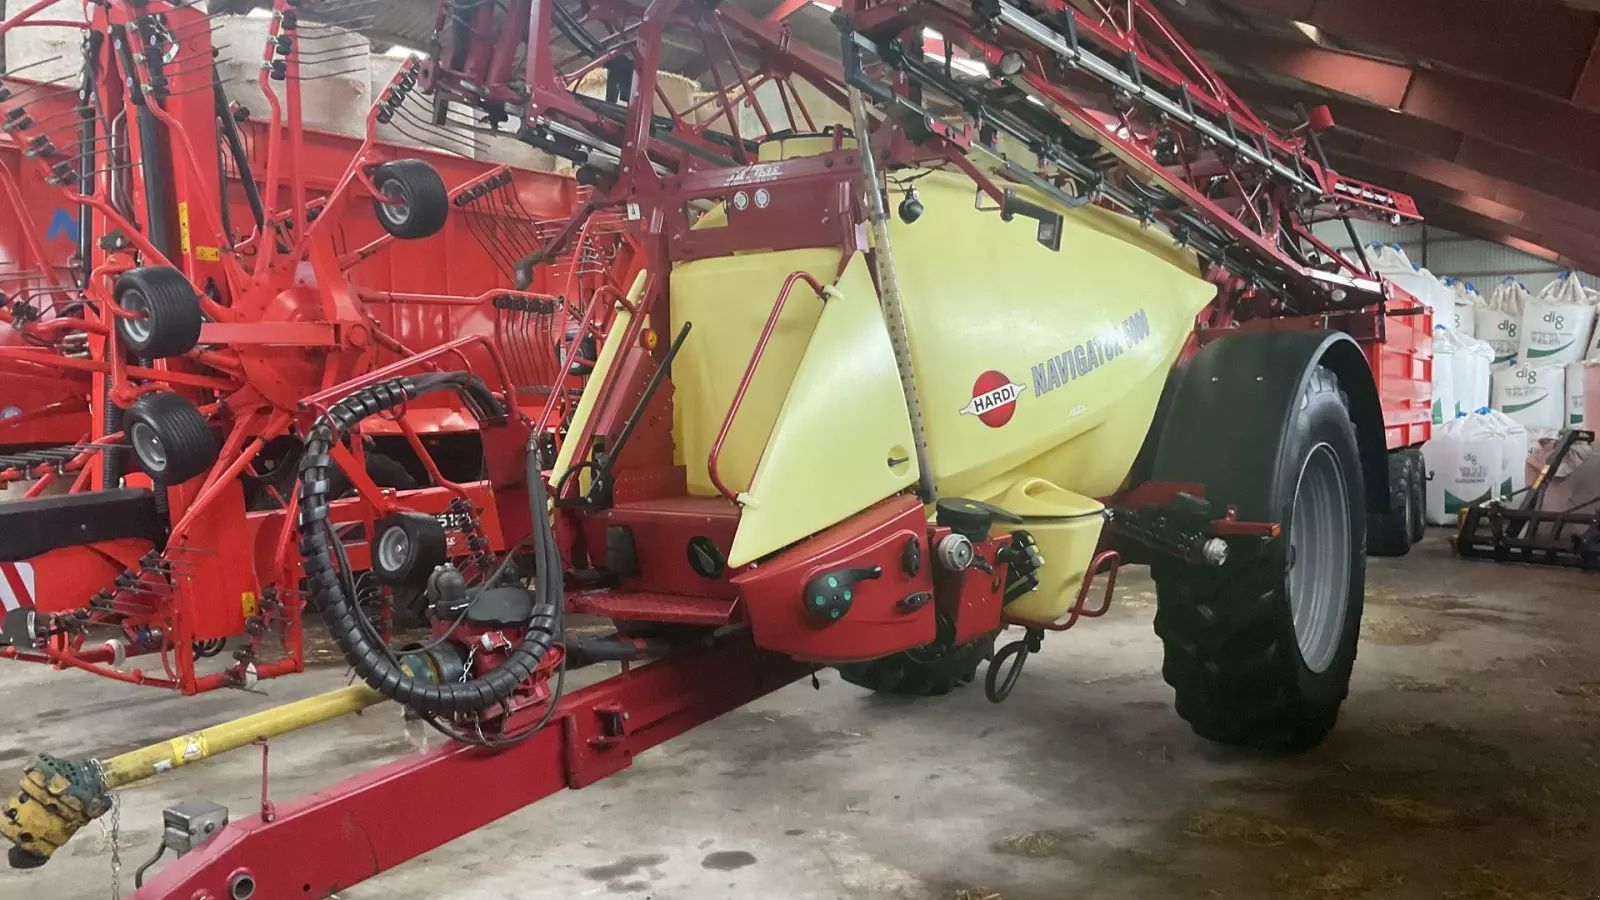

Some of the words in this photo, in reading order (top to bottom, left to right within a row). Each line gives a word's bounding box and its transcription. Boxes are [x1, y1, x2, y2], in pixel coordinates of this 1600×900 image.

[1497, 320, 1517, 338] dlg
[1543, 311, 1564, 330] dlg
[1515, 367, 1537, 384] dlg
[973, 385, 1015, 413] HARDI
